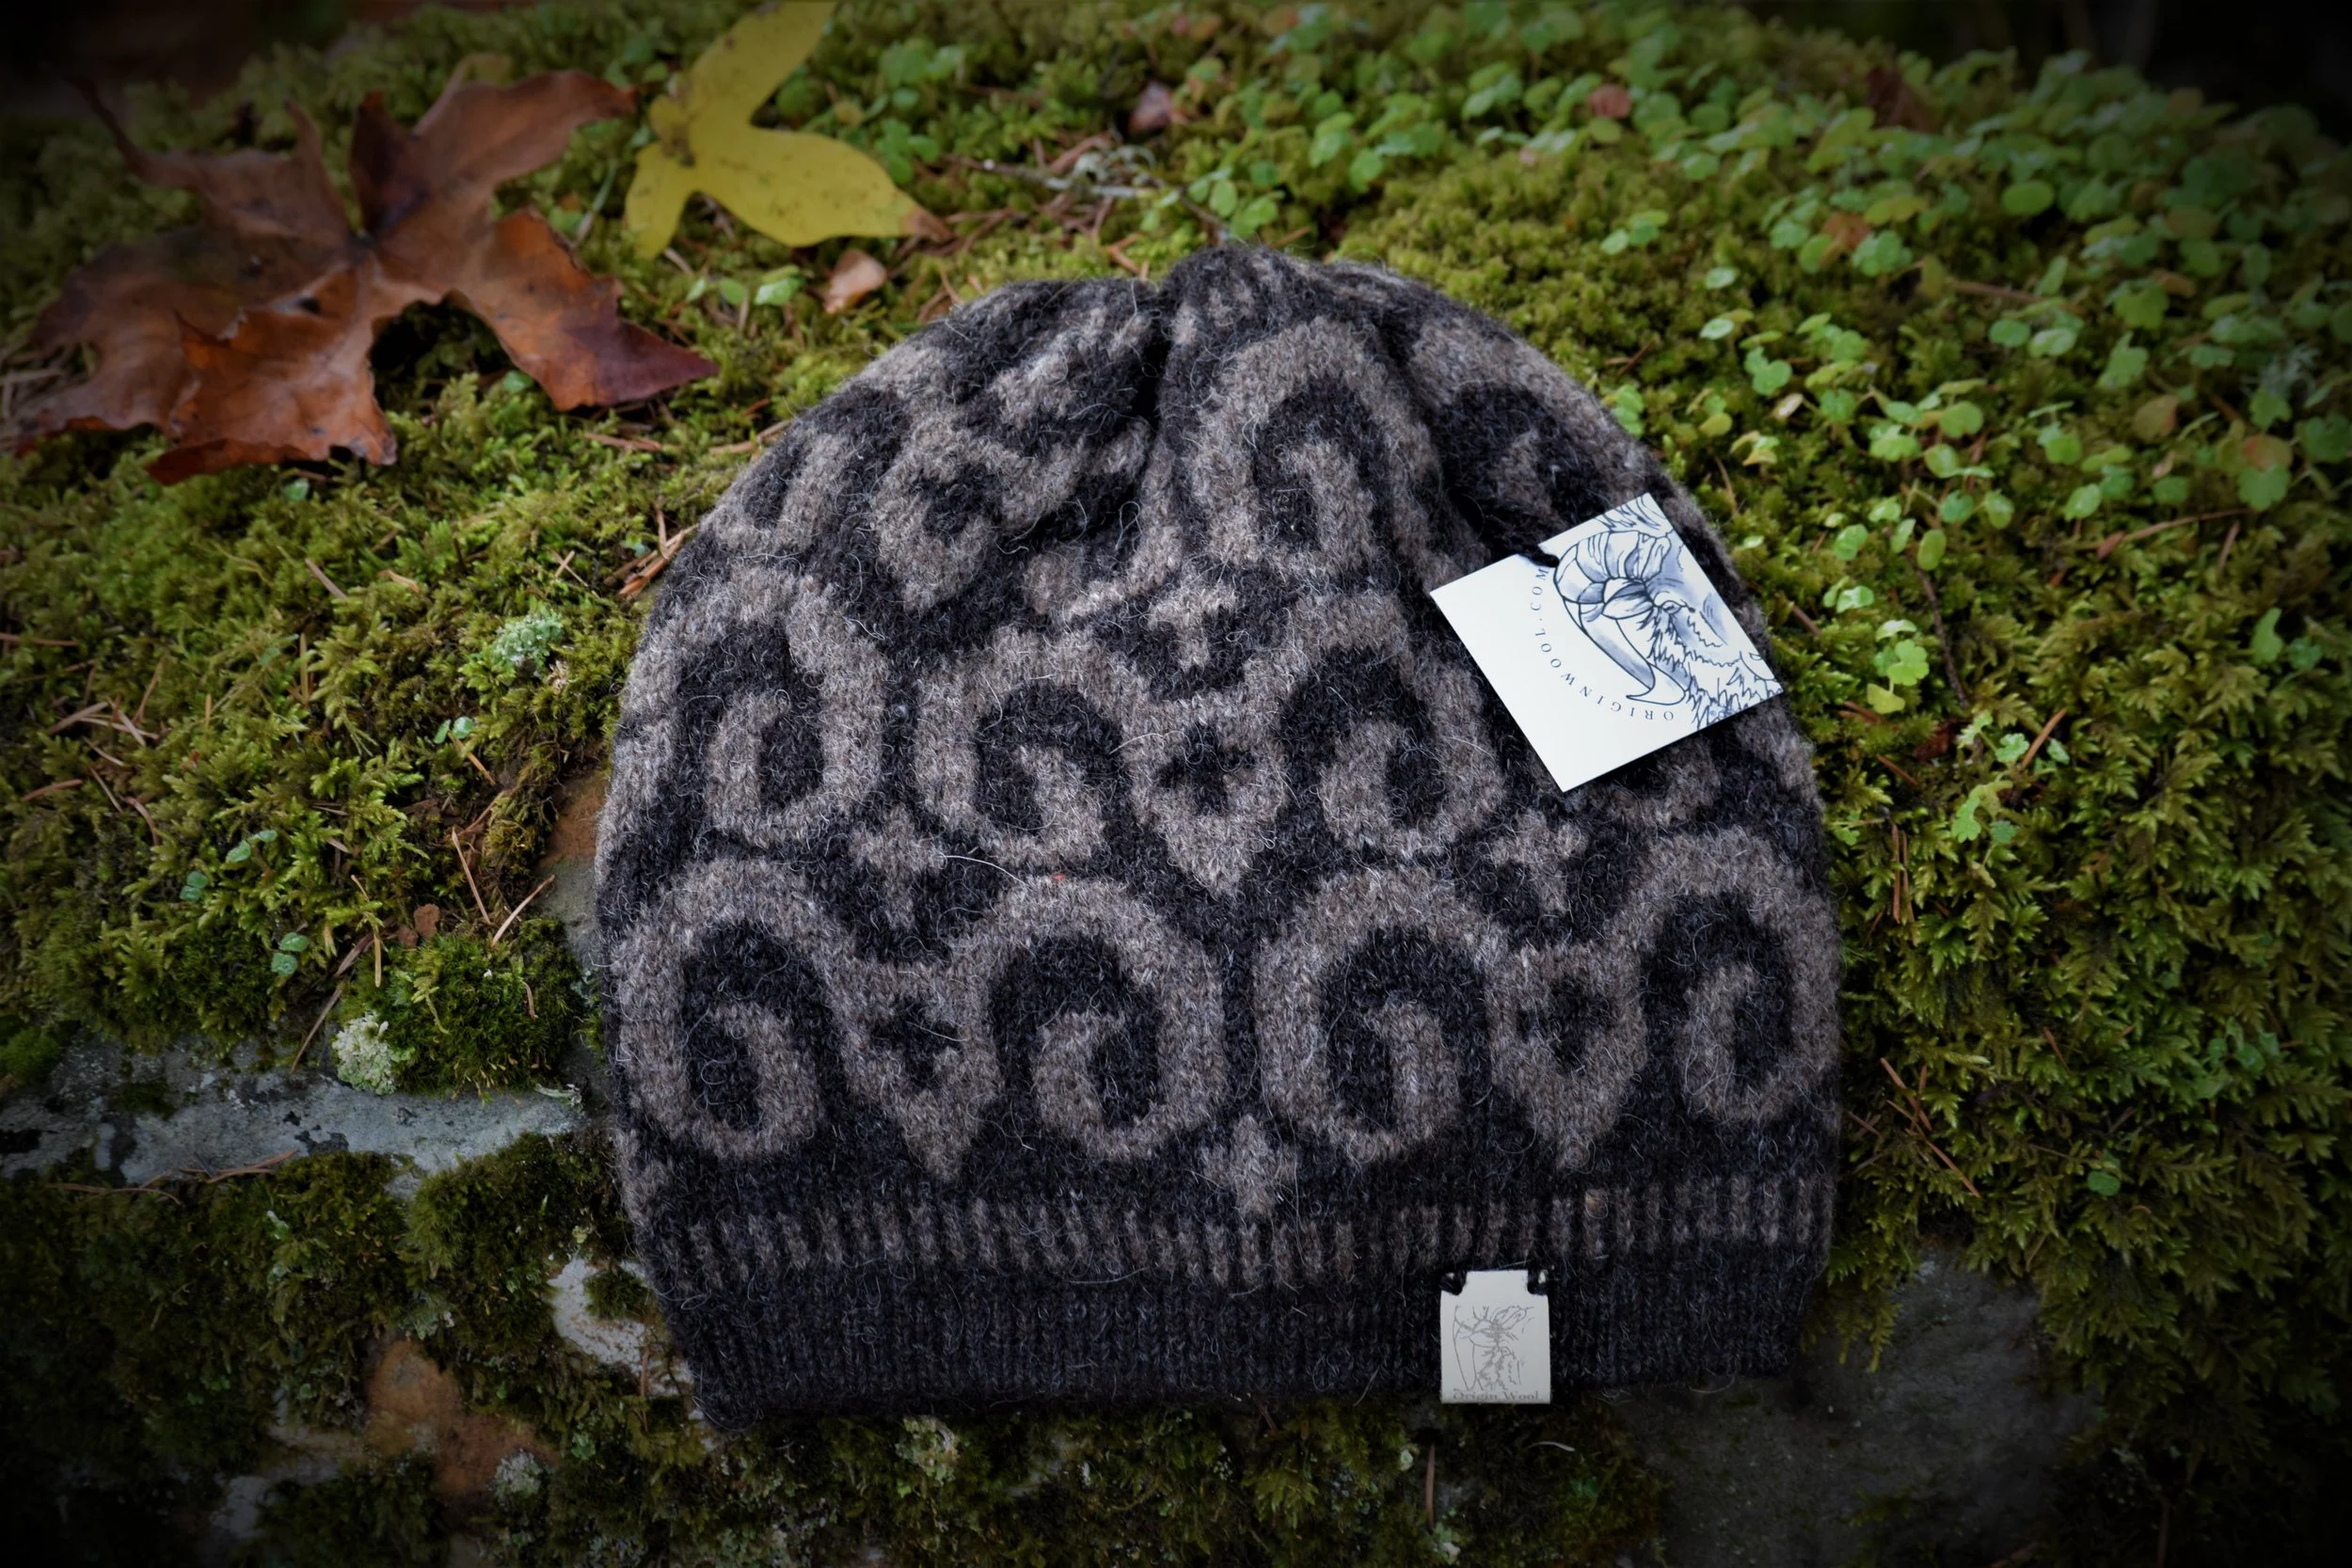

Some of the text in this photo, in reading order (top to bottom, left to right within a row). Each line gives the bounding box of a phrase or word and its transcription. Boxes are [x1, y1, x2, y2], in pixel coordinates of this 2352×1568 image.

[1529, 567, 1675, 721] ORIGINWOOL.COM
[1453, 1388, 1539, 1402] Origin Wool
